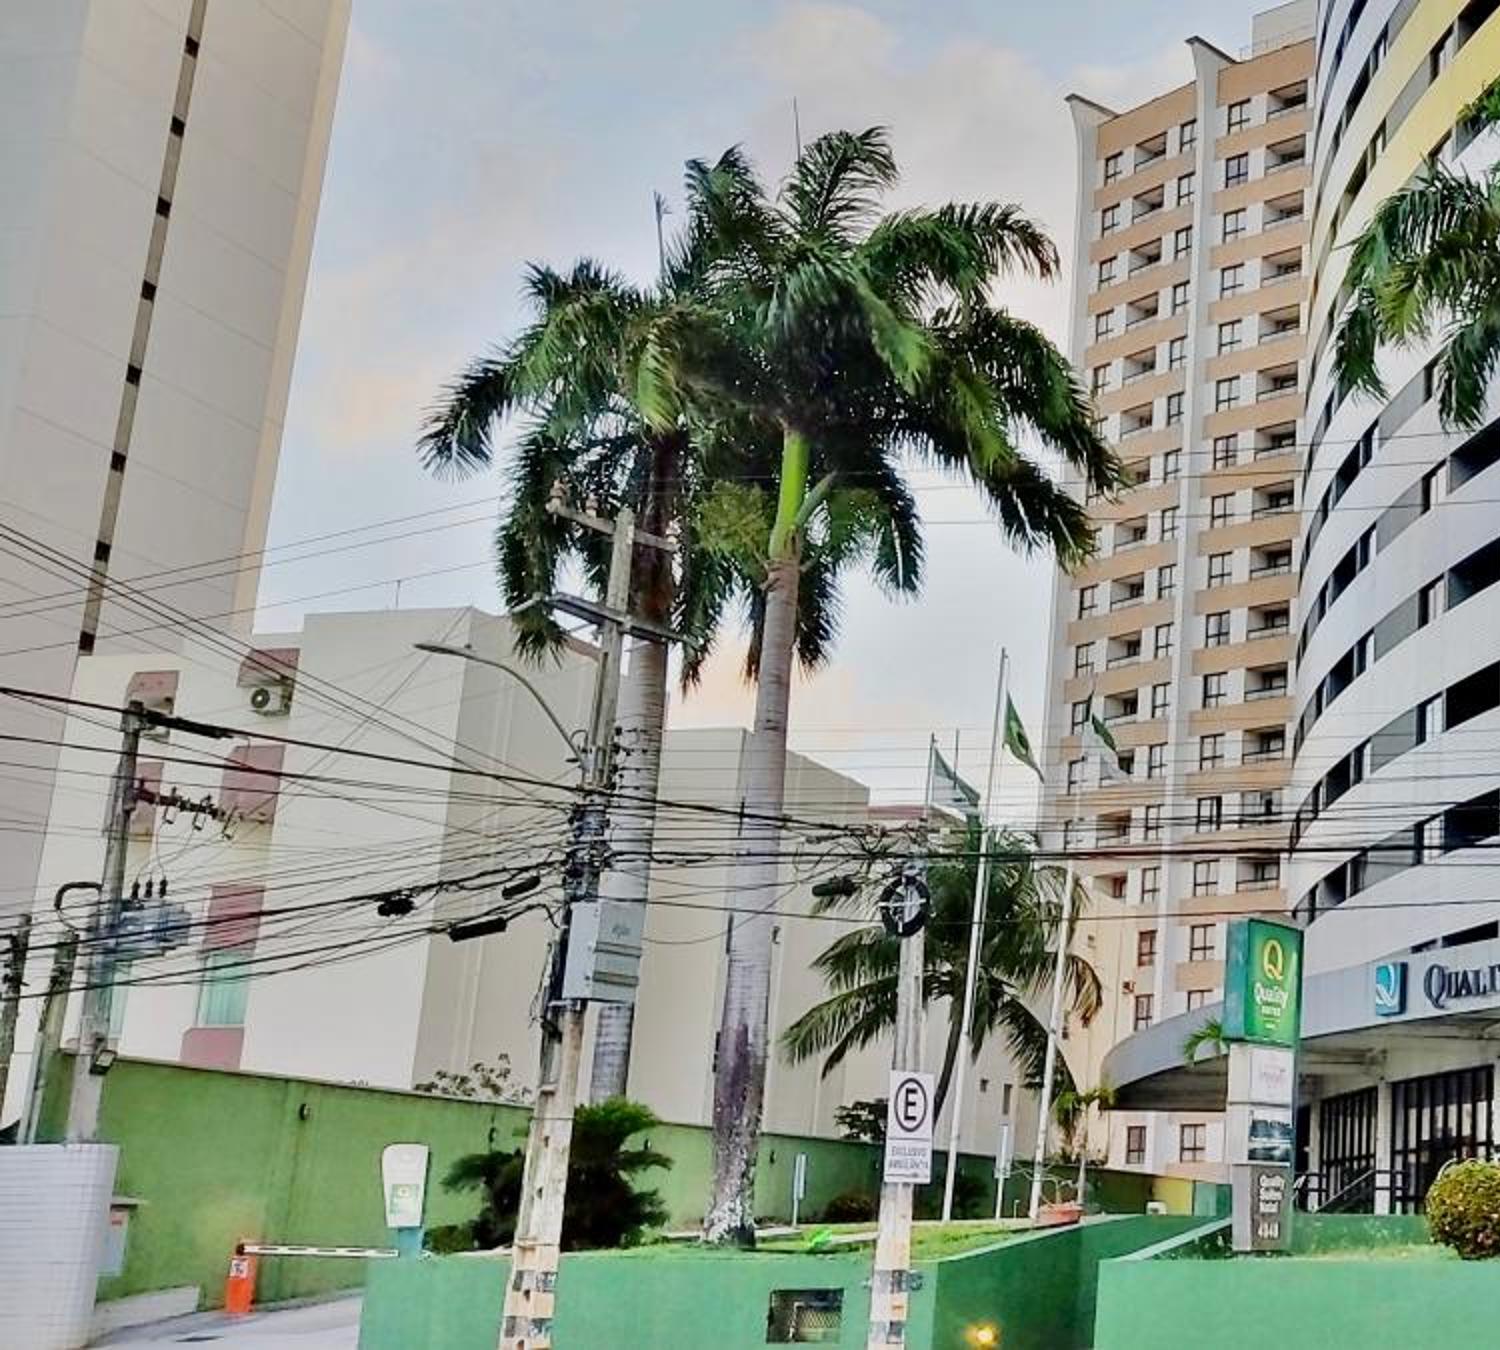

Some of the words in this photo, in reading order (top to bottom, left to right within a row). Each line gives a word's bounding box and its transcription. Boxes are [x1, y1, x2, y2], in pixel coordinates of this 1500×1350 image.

[1262, 939, 1284, 981] Q
[1254, 981, 1289, 1009] Quality
[904, 1087, 918, 1121] E
